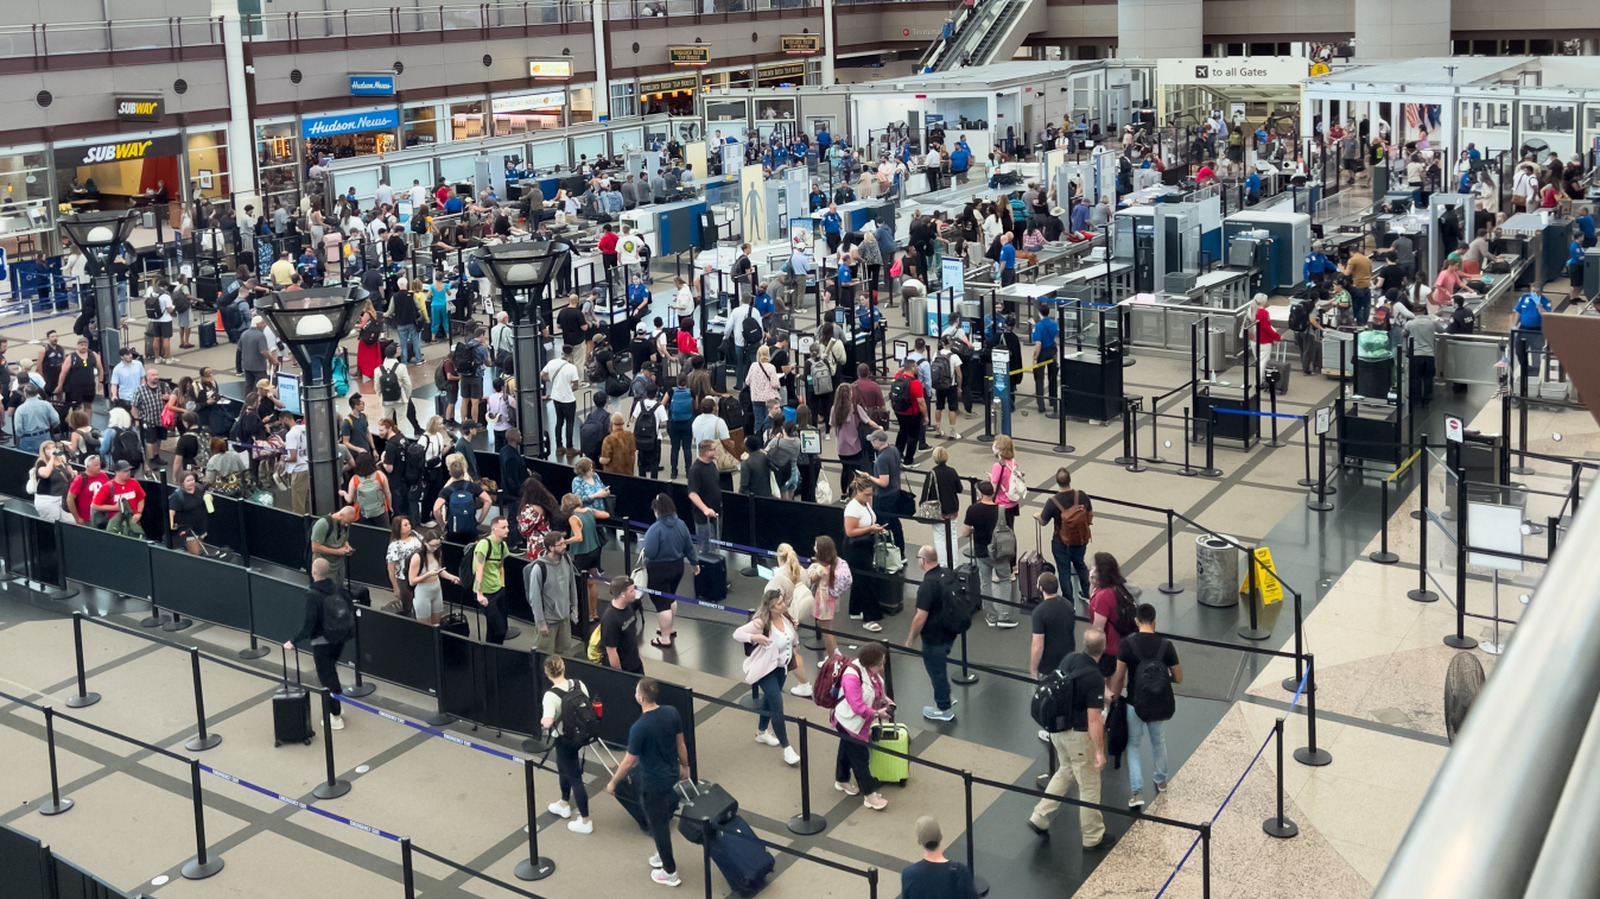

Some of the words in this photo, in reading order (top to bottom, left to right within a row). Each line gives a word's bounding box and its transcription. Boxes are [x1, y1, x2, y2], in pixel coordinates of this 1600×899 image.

[1212, 68, 1223, 76] to
[1226, 68, 1236, 76] all
[1240, 68, 1267, 76] Gates
[351, 81, 373, 89] Hudson
[373, 81, 392, 89] News
[118, 101, 158, 115] SUBWAY
[308, 119, 357, 135] Hudson
[356, 116, 392, 128] News
[83, 140, 153, 164] SUBWAY
